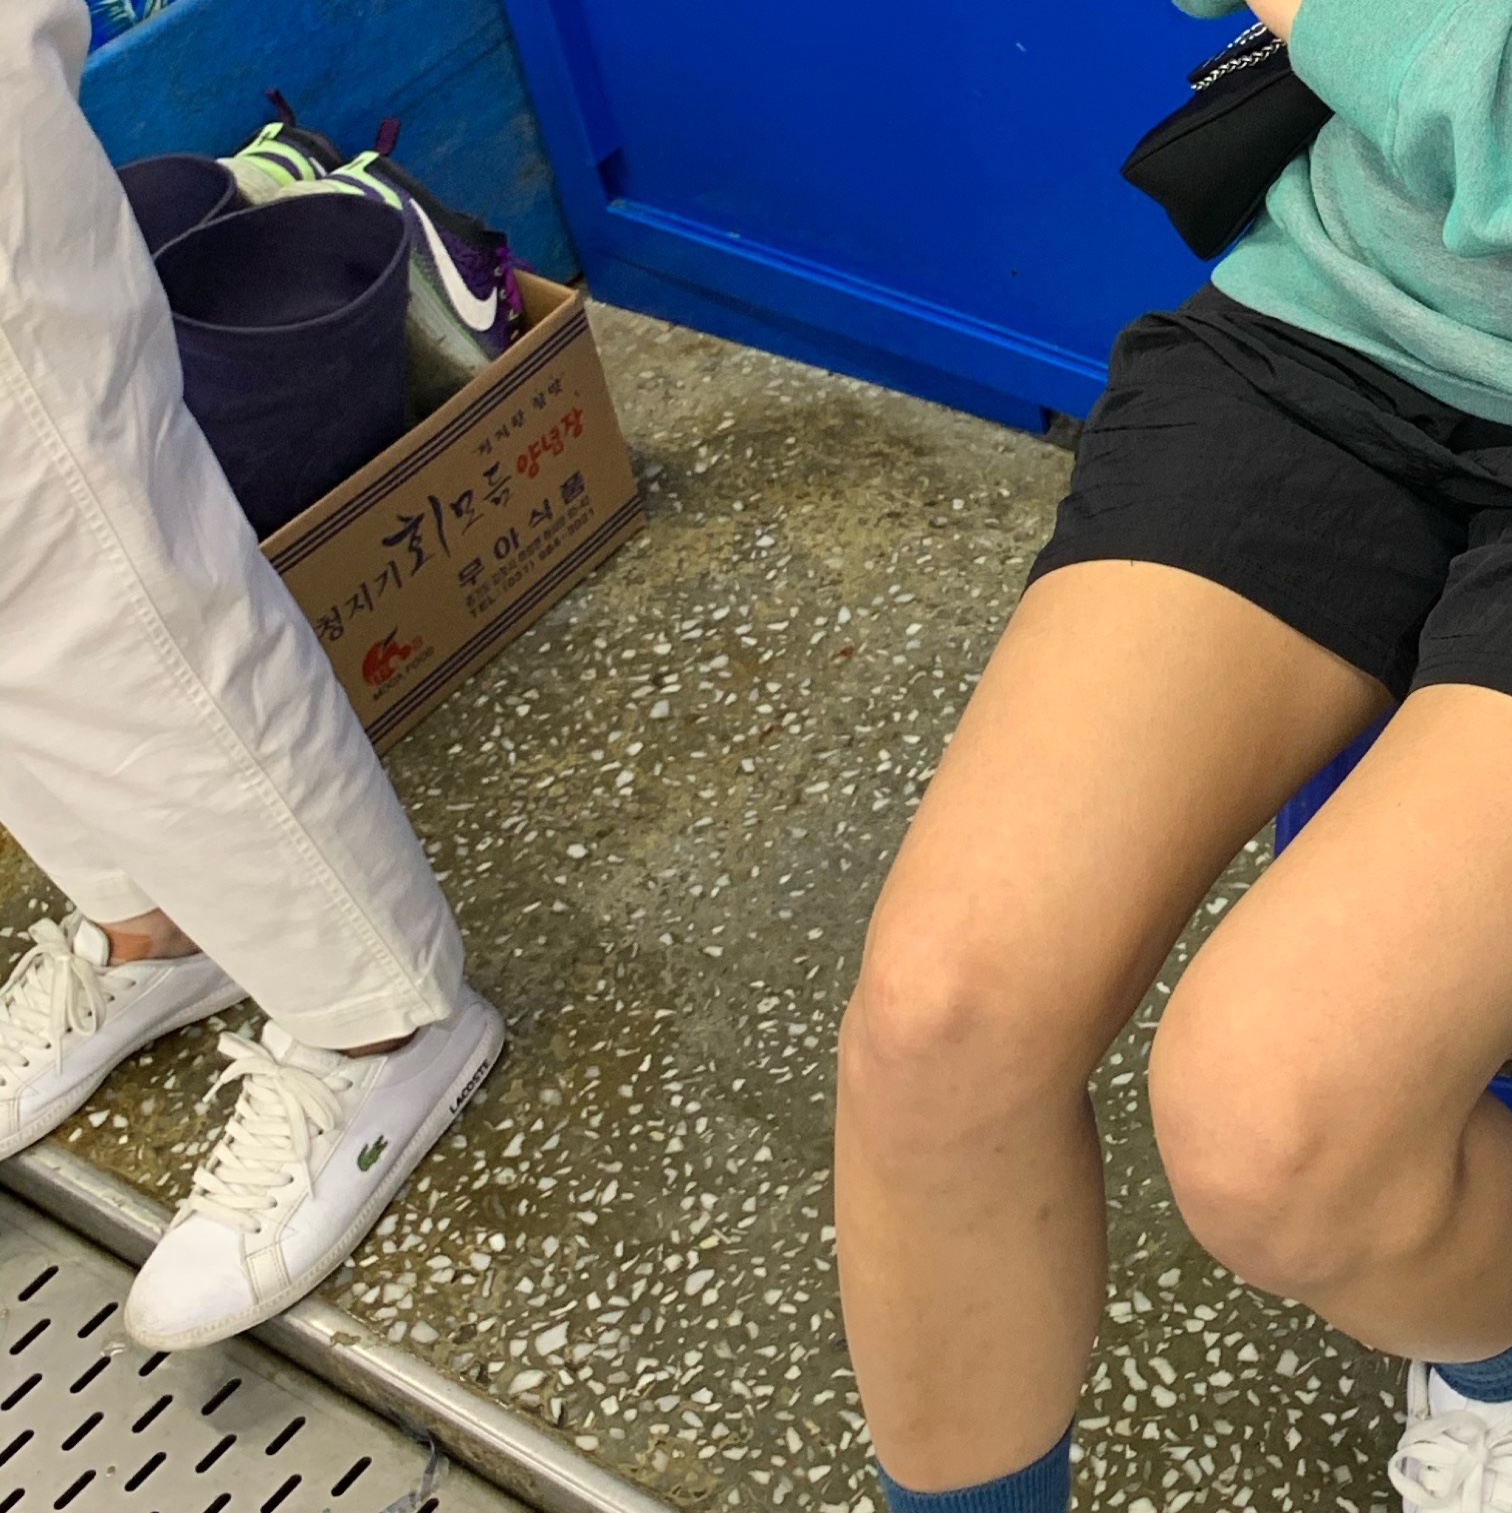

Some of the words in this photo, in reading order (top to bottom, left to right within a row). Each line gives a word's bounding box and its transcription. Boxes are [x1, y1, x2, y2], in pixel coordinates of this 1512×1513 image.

[316, 559, 403, 641] 청지기
[517, 407, 583, 479] 양념장
[449, 1058, 490, 1114] LACOSTE
